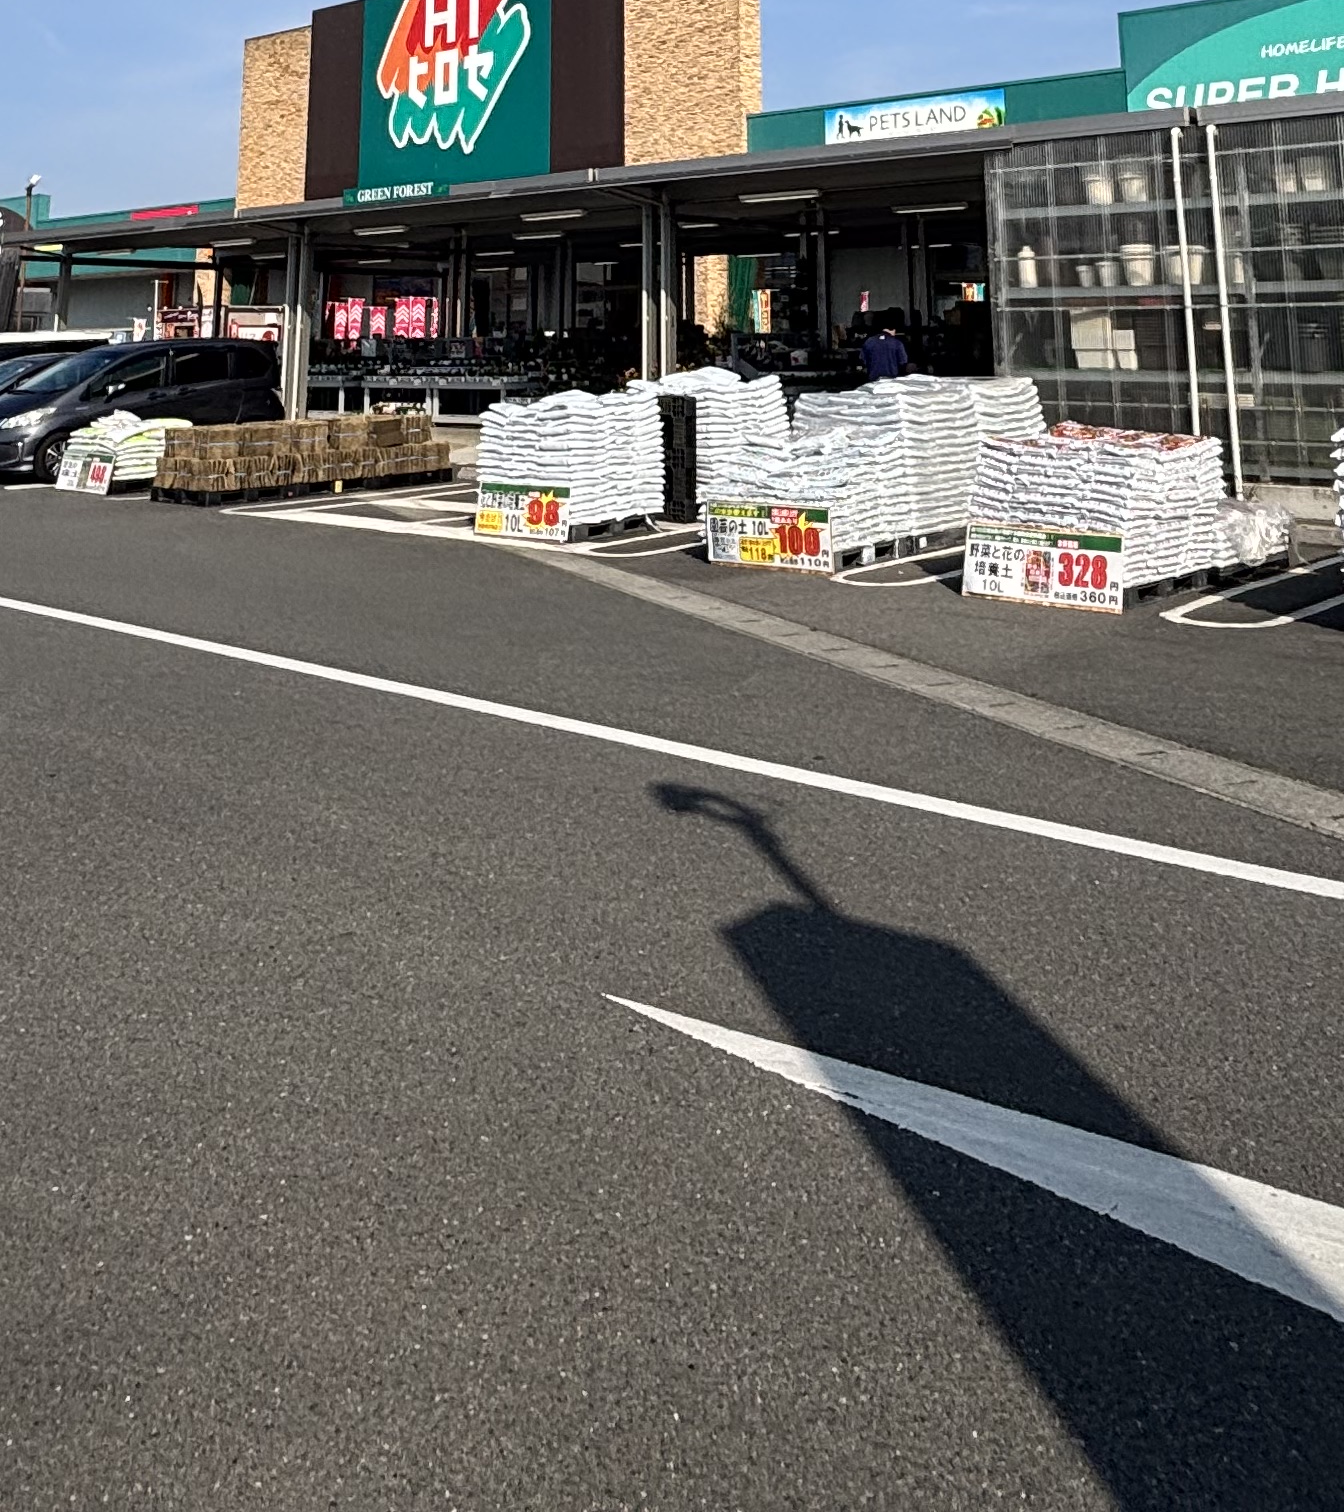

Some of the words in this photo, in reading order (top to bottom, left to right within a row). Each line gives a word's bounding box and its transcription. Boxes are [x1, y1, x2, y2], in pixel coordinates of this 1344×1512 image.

[408, 45, 494, 109] ヒロセ
[357, 187, 391, 202] GREEN
[393, 182, 434, 198] FOREST
[527, 499, 560, 527] 98
[505, 514, 523, 533] 10L
[776, 525, 820, 557] 100
[969, 543, 1025, 561] 野菜と花の
[975, 561, 1013, 579] 培養土
[1058, 552, 1108, 590] 328
[982, 579, 1004, 593] 10L
